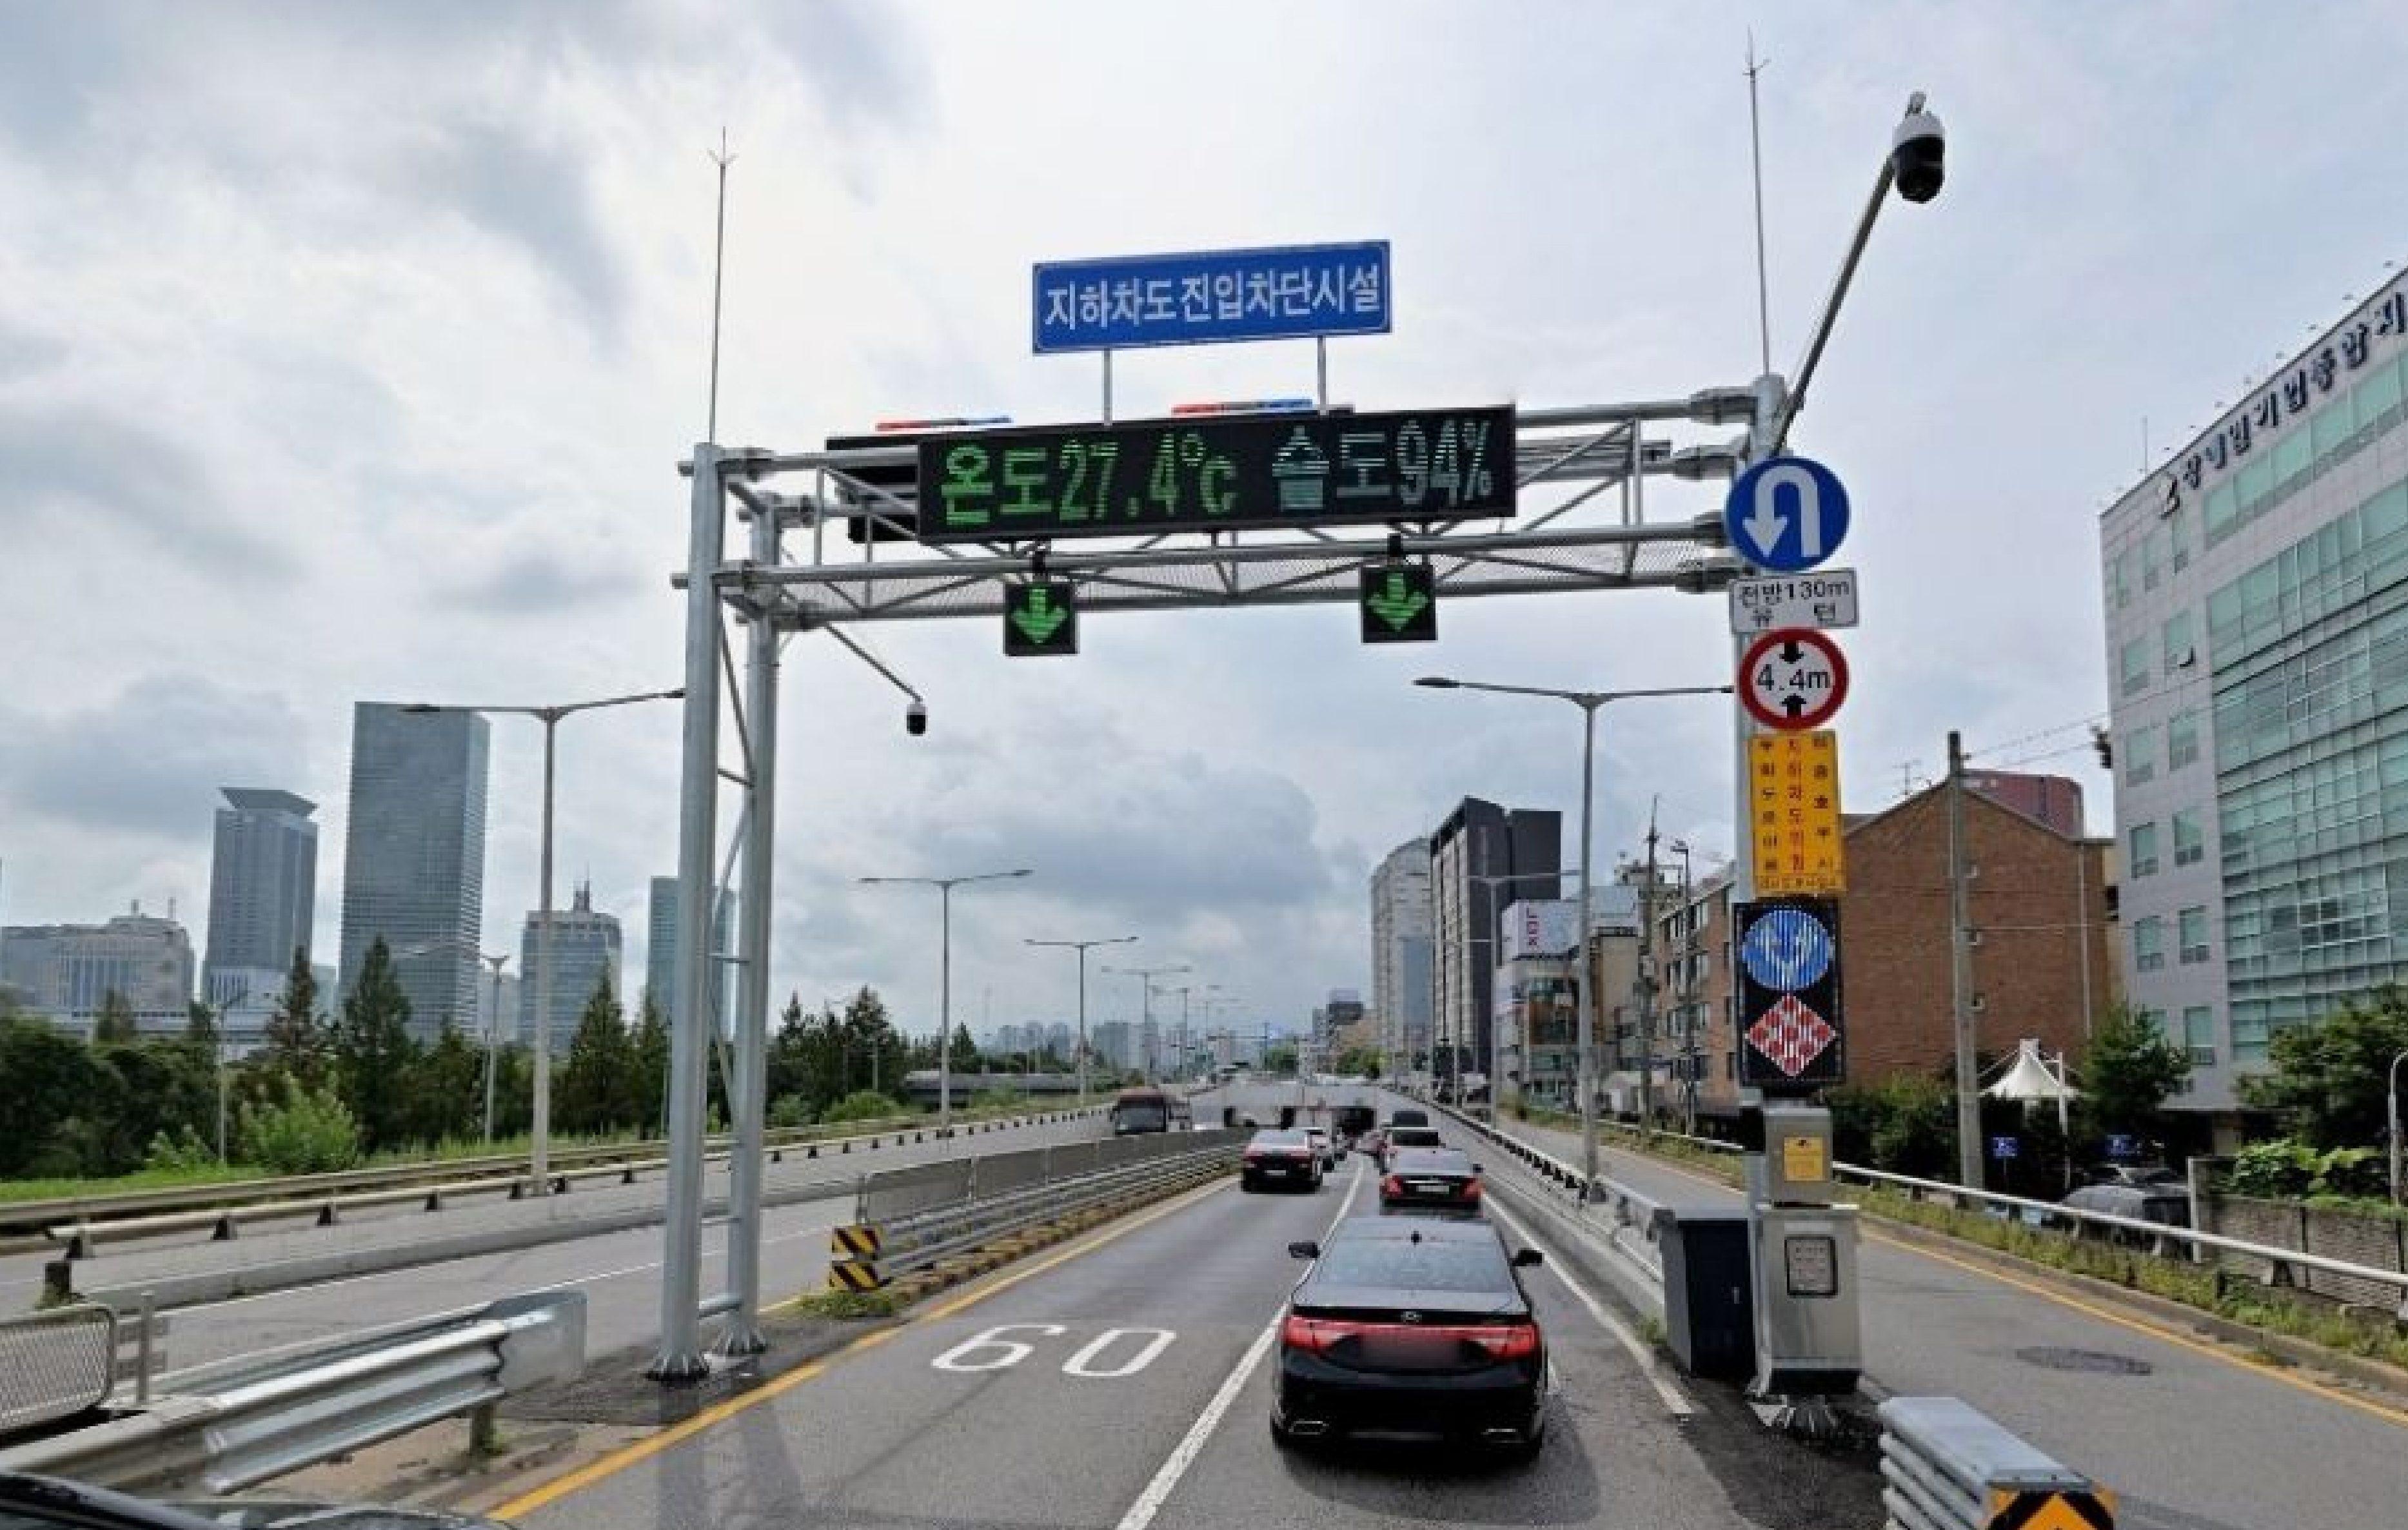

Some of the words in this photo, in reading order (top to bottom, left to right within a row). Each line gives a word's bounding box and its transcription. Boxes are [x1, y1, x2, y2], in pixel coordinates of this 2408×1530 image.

[1045, 264, 1381, 329] 지하차도진입차단시설
[1272, 420, 1493, 509] 습도94%
[1757, 663, 1831, 692] 4.4m
[931, 1324, 1177, 1377] 60
